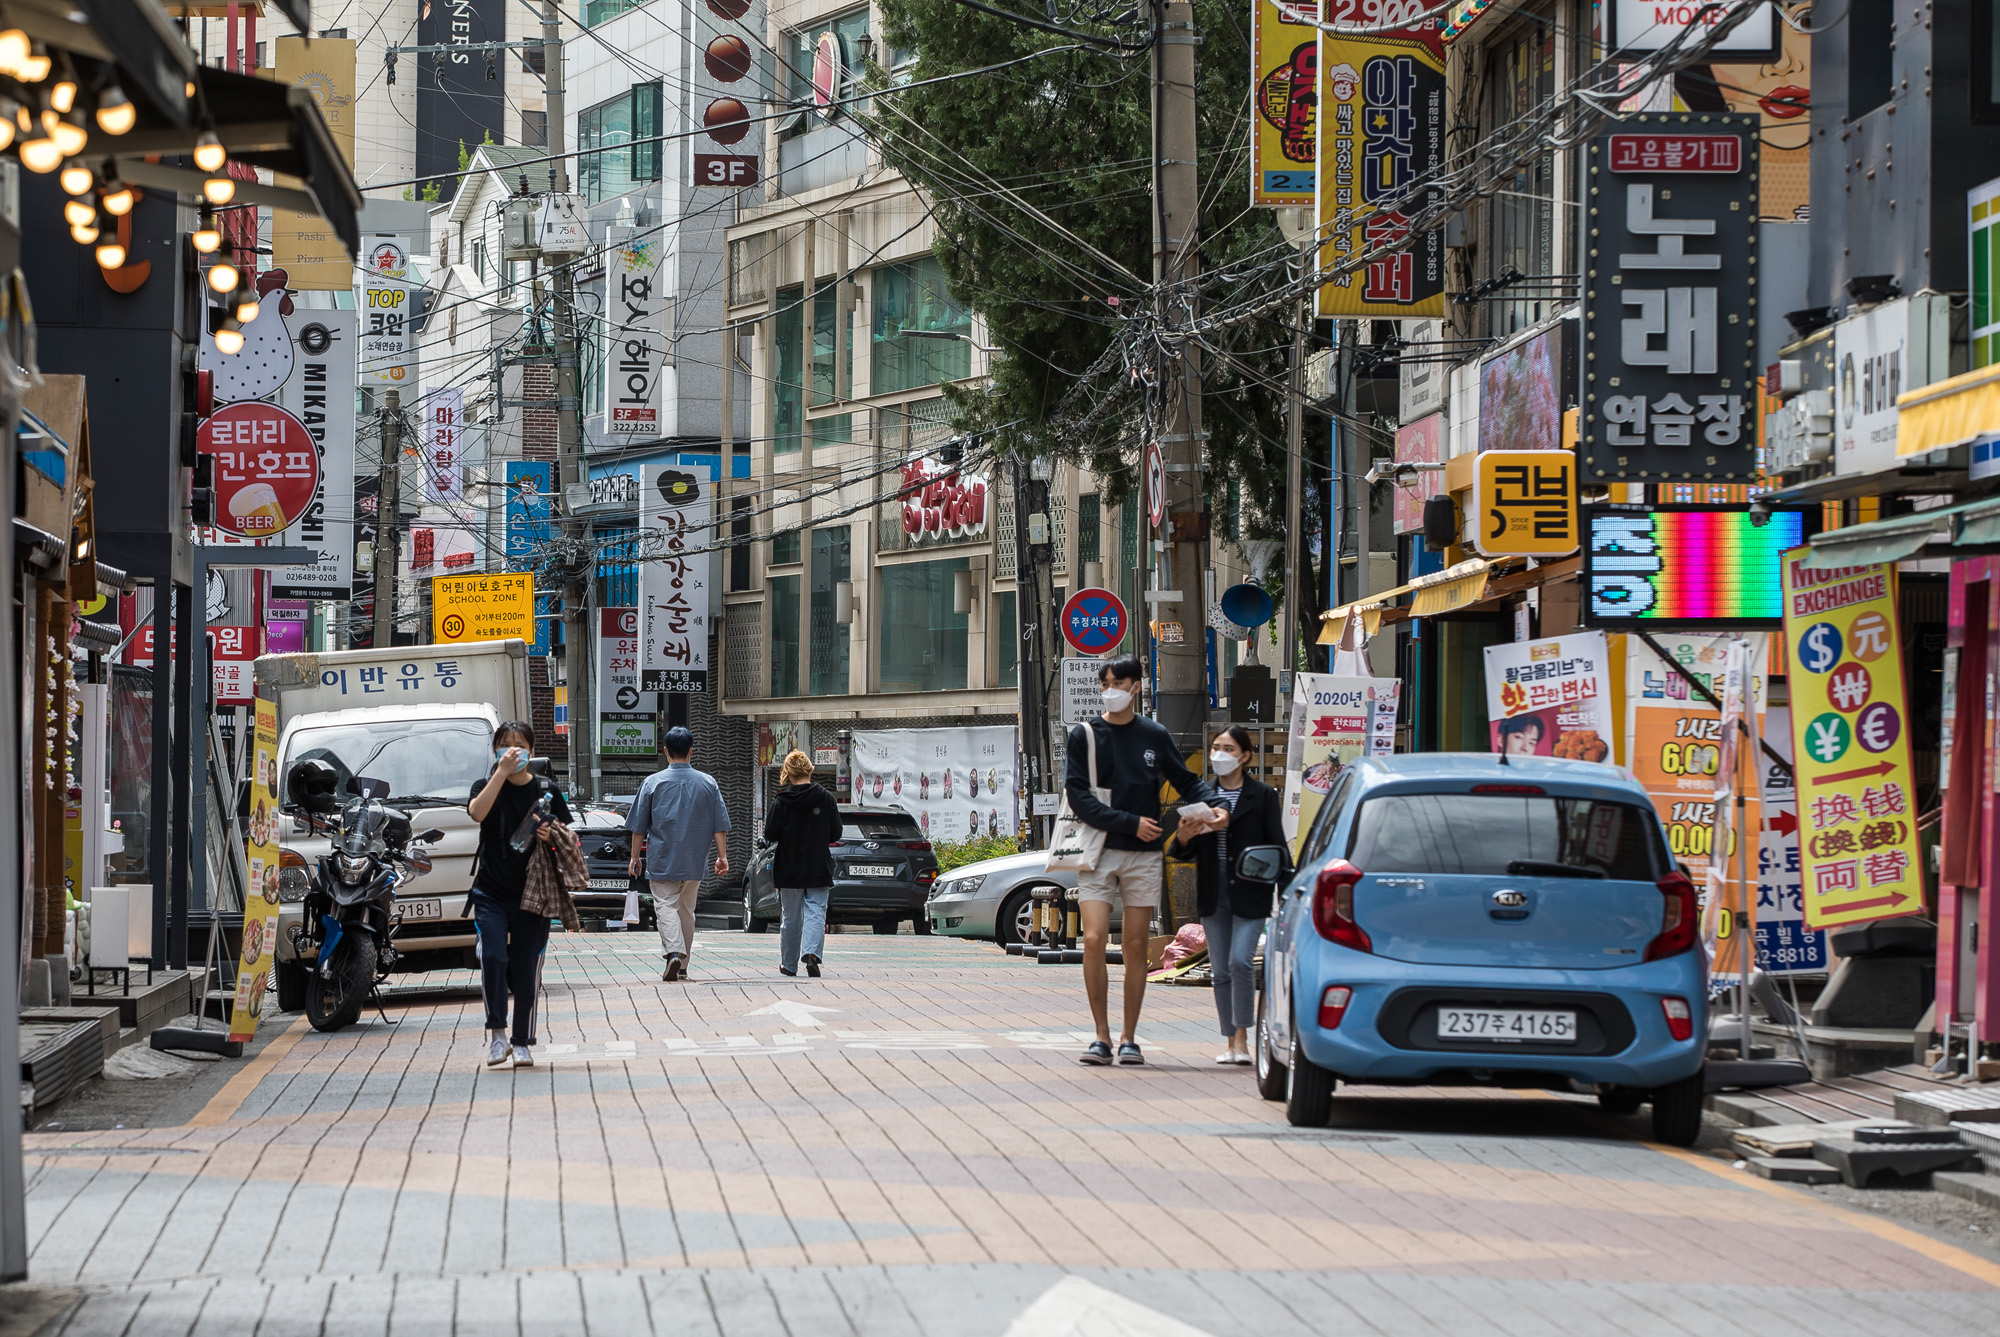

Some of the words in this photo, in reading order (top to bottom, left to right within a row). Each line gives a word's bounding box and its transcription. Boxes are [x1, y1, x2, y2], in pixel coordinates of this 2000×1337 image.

[707, 160, 745, 182] 3F
[297, 232, 326, 243] Pasta
[297, 254, 324, 265] Pizza
[1619, 183, 1722, 375] 노래
[367, 288, 405, 309] TOP
[368, 313, 404, 337] 코인
[367, 341, 403, 352] 노래연습장
[393, 368, 403, 377] B1
[616, 409, 632, 420] 3F
[1603, 392, 1746, 446] 연습장
[211, 419, 286, 445] 로타리
[613, 423, 656, 432] 322.3252
[199, 450, 312, 481] 킨·호프
[236, 515, 274, 529] BEER
[286, 573, 337, 582] 02)6489-0208
[441, 579, 526, 594] 어린이보호구역
[448, 596, 487, 604] SCHOOL
[492, 594, 518, 602] ZONE
[1792, 574, 1886, 618] EXCHANGE
[446, 621, 461, 632] 30
[1071, 616, 1119, 628] 주정차금지
[1854, 615, 1889, 658] 元
[1807, 623, 1834, 673] $
[609, 658, 638, 673] 주차
[321, 661, 463, 695] 이반유통
[646, 681, 702, 692] 3143-6635
[1561, 677, 1598, 700] 변신
[1833, 669, 1868, 709] ₩
[1314, 691, 1363, 708] 2020년
[1862, 707, 1890, 750] €
[1313, 738, 1355, 747] vegetarian
[1812, 717, 1841, 762] ¥
[870, 865, 892, 876] 8471
[609, 879, 628, 889] 1320
[1496, 893, 1525, 906] KIA
[398, 902, 431, 918] 9181
[1510, 1014, 1568, 1036] 4165
